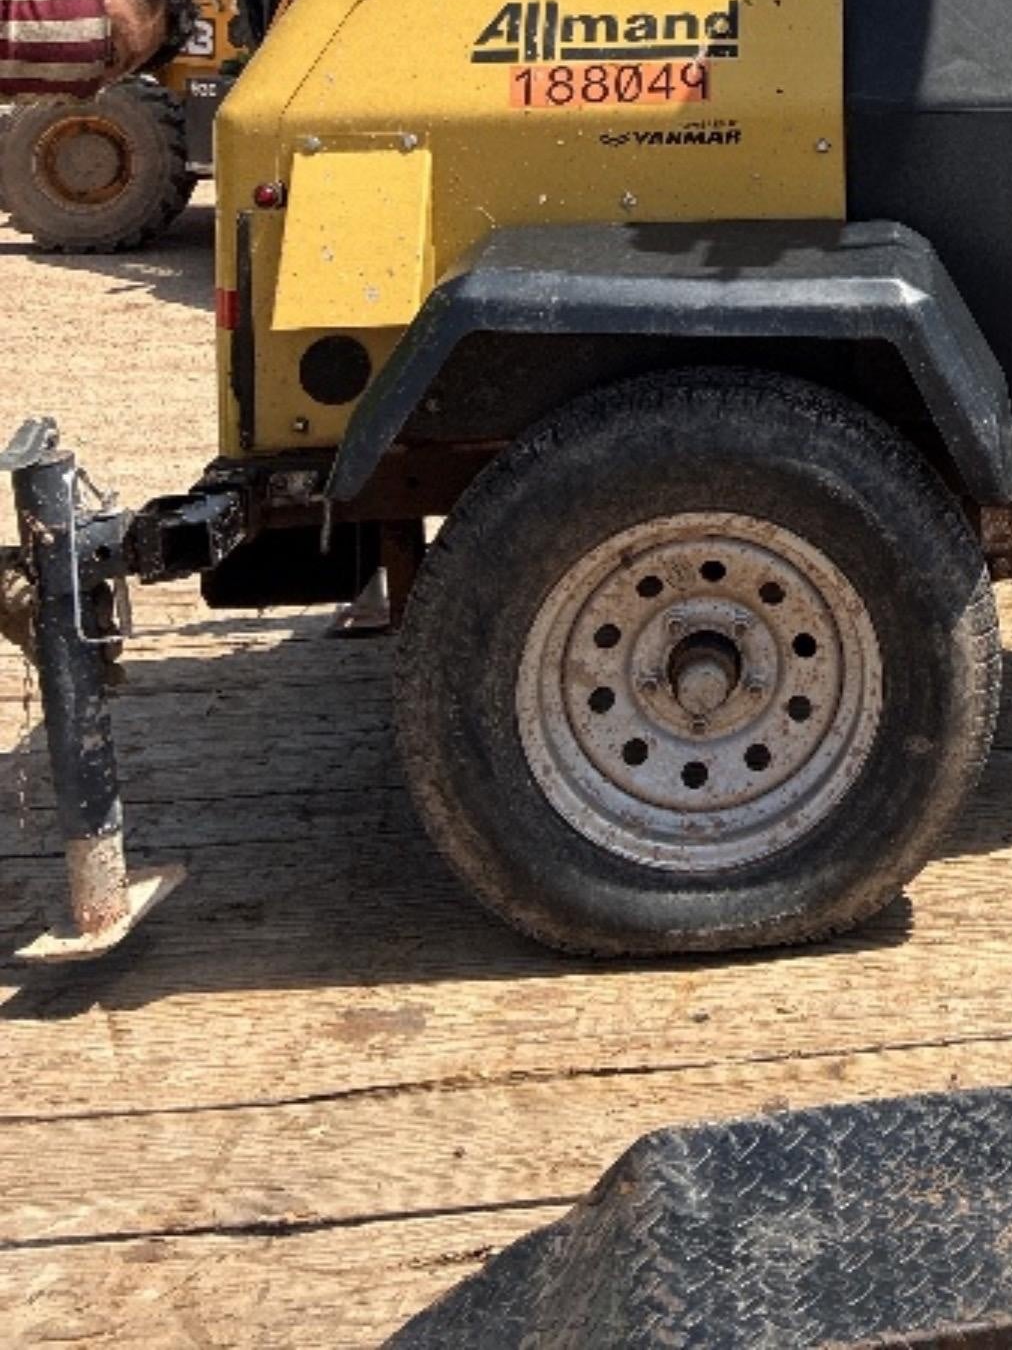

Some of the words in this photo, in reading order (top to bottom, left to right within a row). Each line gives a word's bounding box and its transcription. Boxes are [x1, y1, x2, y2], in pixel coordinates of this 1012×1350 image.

[471, 0, 740, 62] Allmand
[514, 63, 710, 106] 188049
[633, 129, 742, 145] YANMAR
